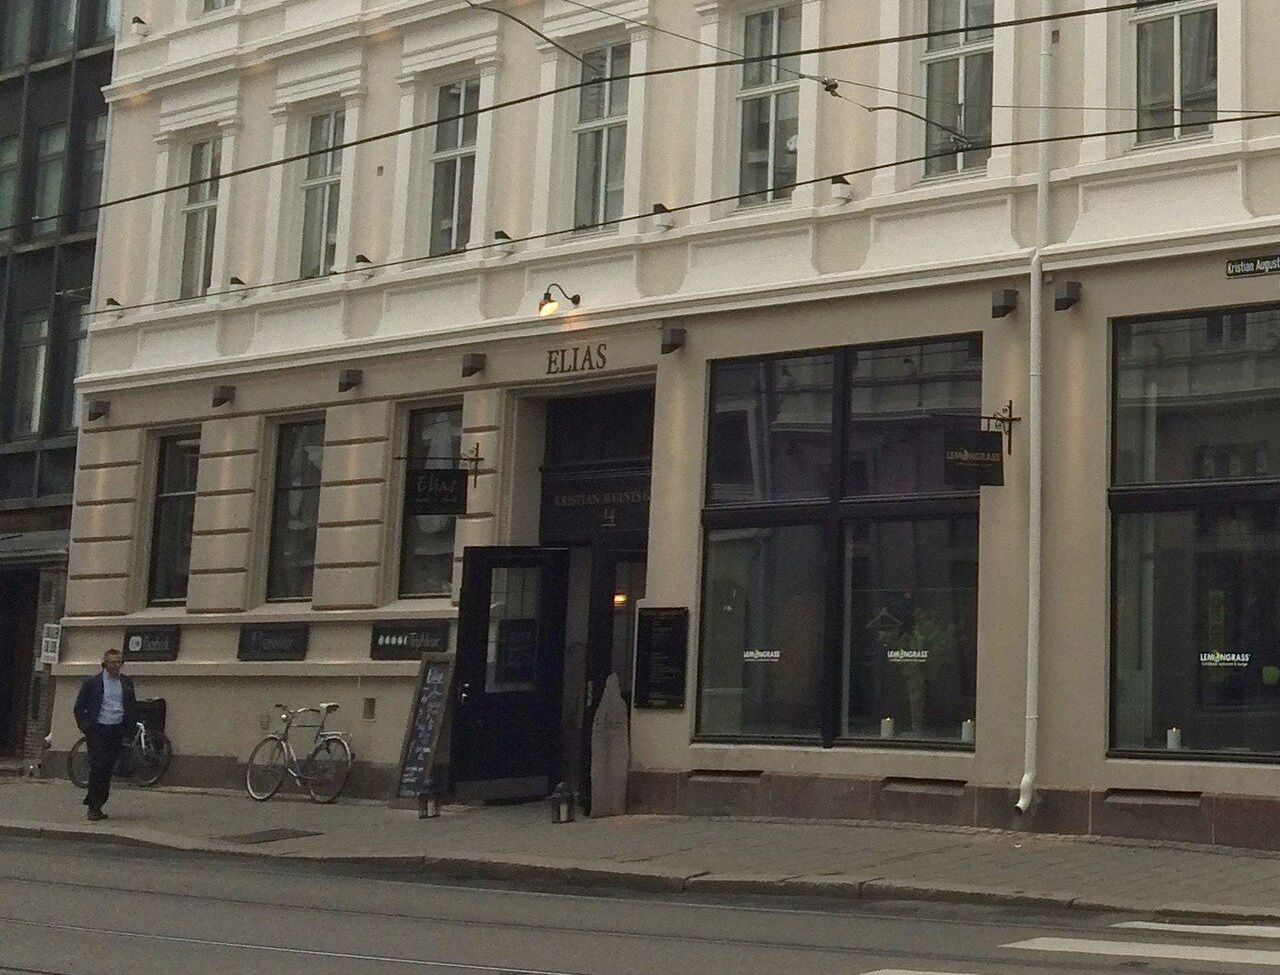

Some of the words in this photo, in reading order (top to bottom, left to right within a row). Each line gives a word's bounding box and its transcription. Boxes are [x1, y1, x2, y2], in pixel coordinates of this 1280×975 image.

[1228, 261, 1254, 274] Kristian
[546, 343, 607, 375] ELIAS
[946, 449, 1000, 461] LEMONGRASS
[1200, 652, 1250, 662] LEMONGRASS
